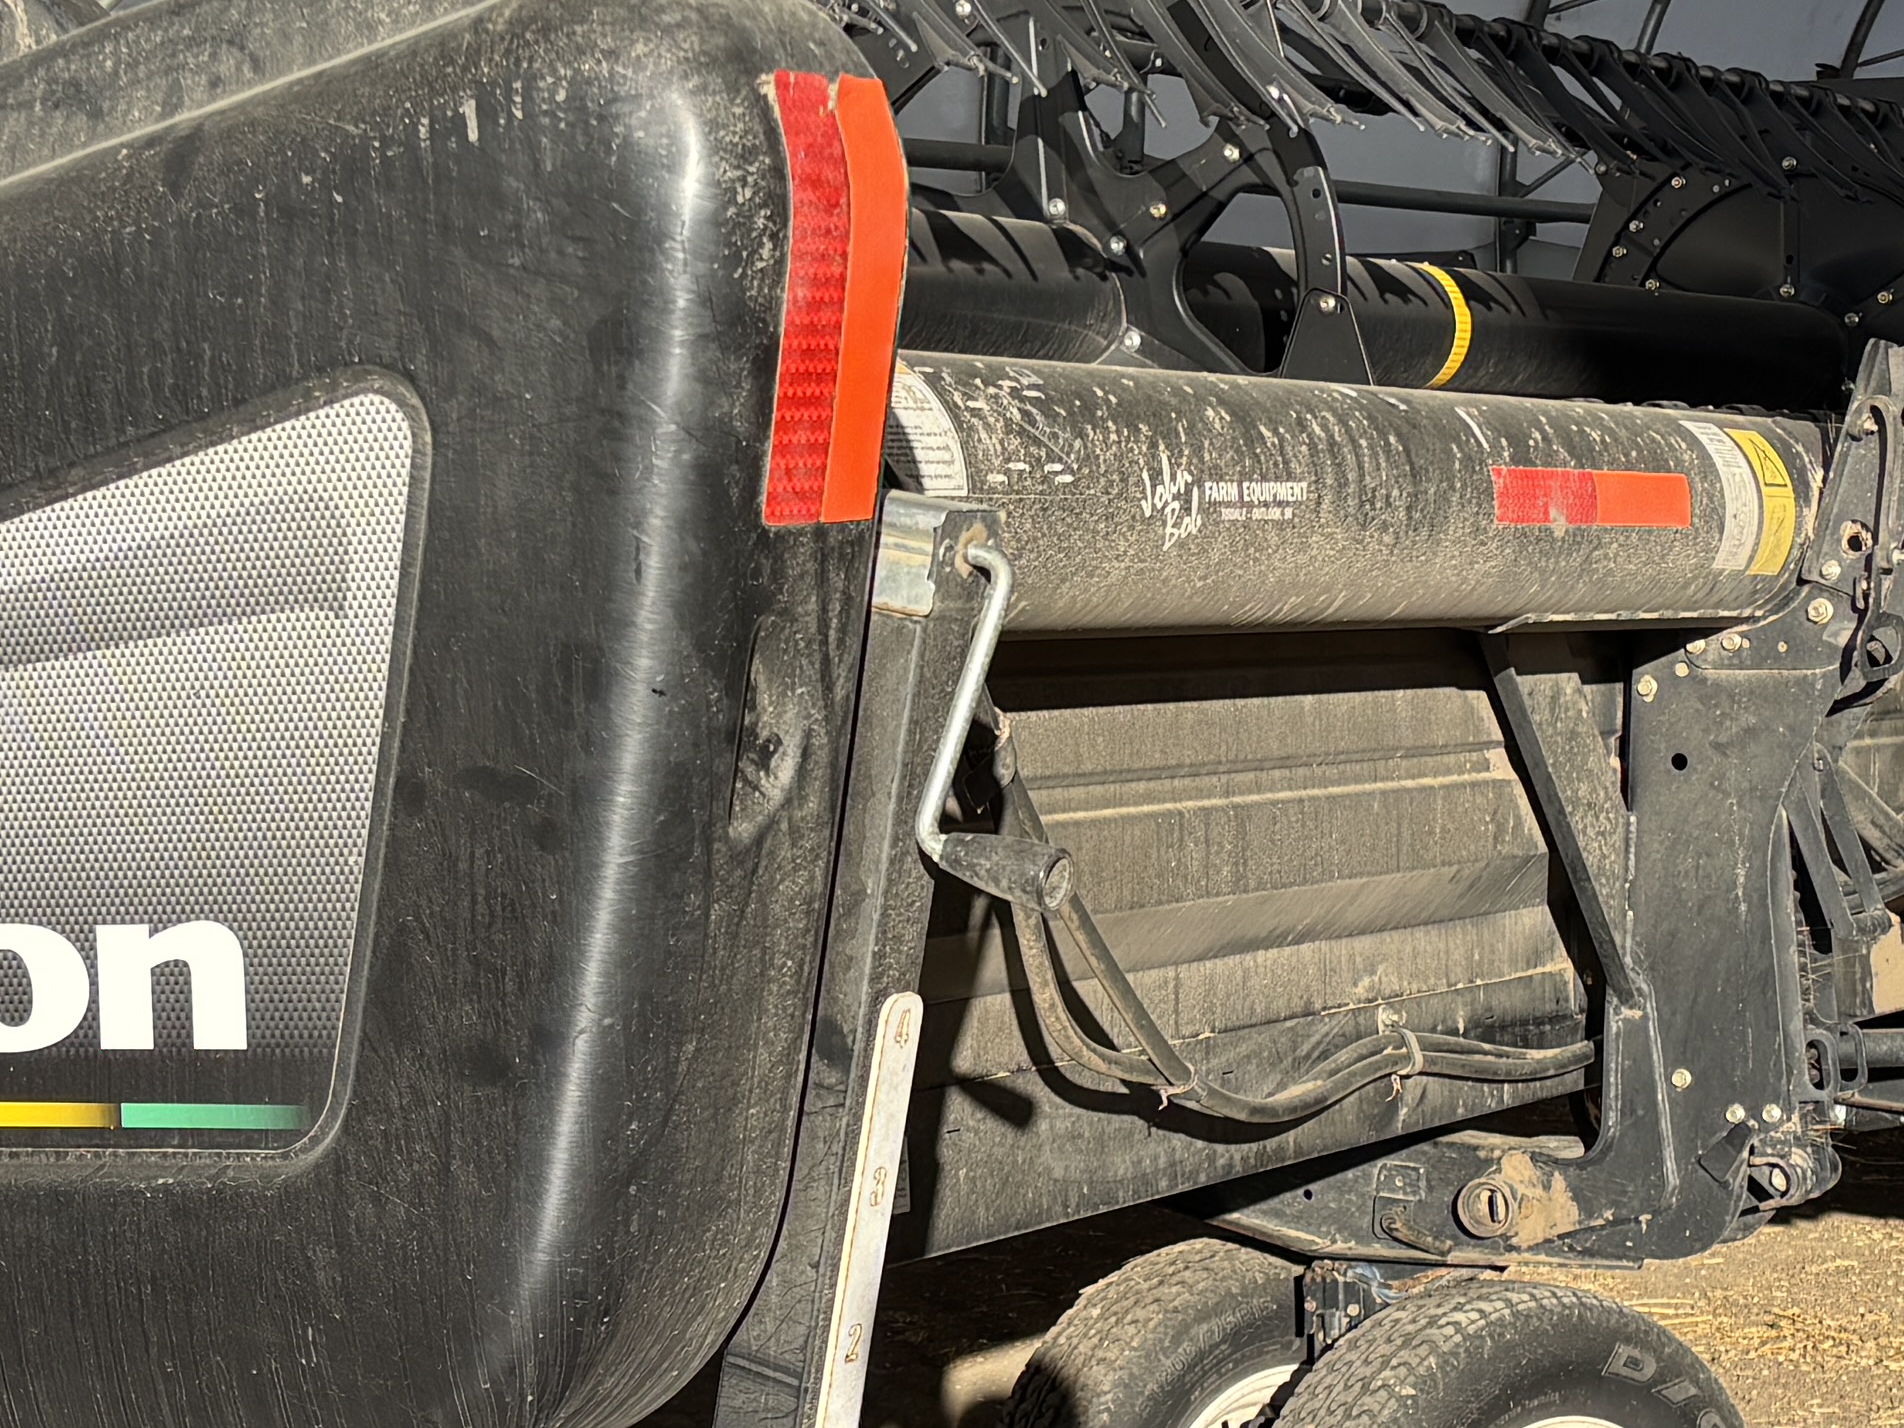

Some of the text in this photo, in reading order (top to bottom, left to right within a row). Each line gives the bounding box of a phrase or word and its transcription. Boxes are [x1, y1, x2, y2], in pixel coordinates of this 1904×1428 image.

[1204, 481, 1308, 504] FARM EQUIPMENT
[1162, 486, 1202, 551] Bob
[893, 1007, 911, 1049] 4
[869, 1166, 888, 1208] 3
[844, 1322, 864, 1365] 2
